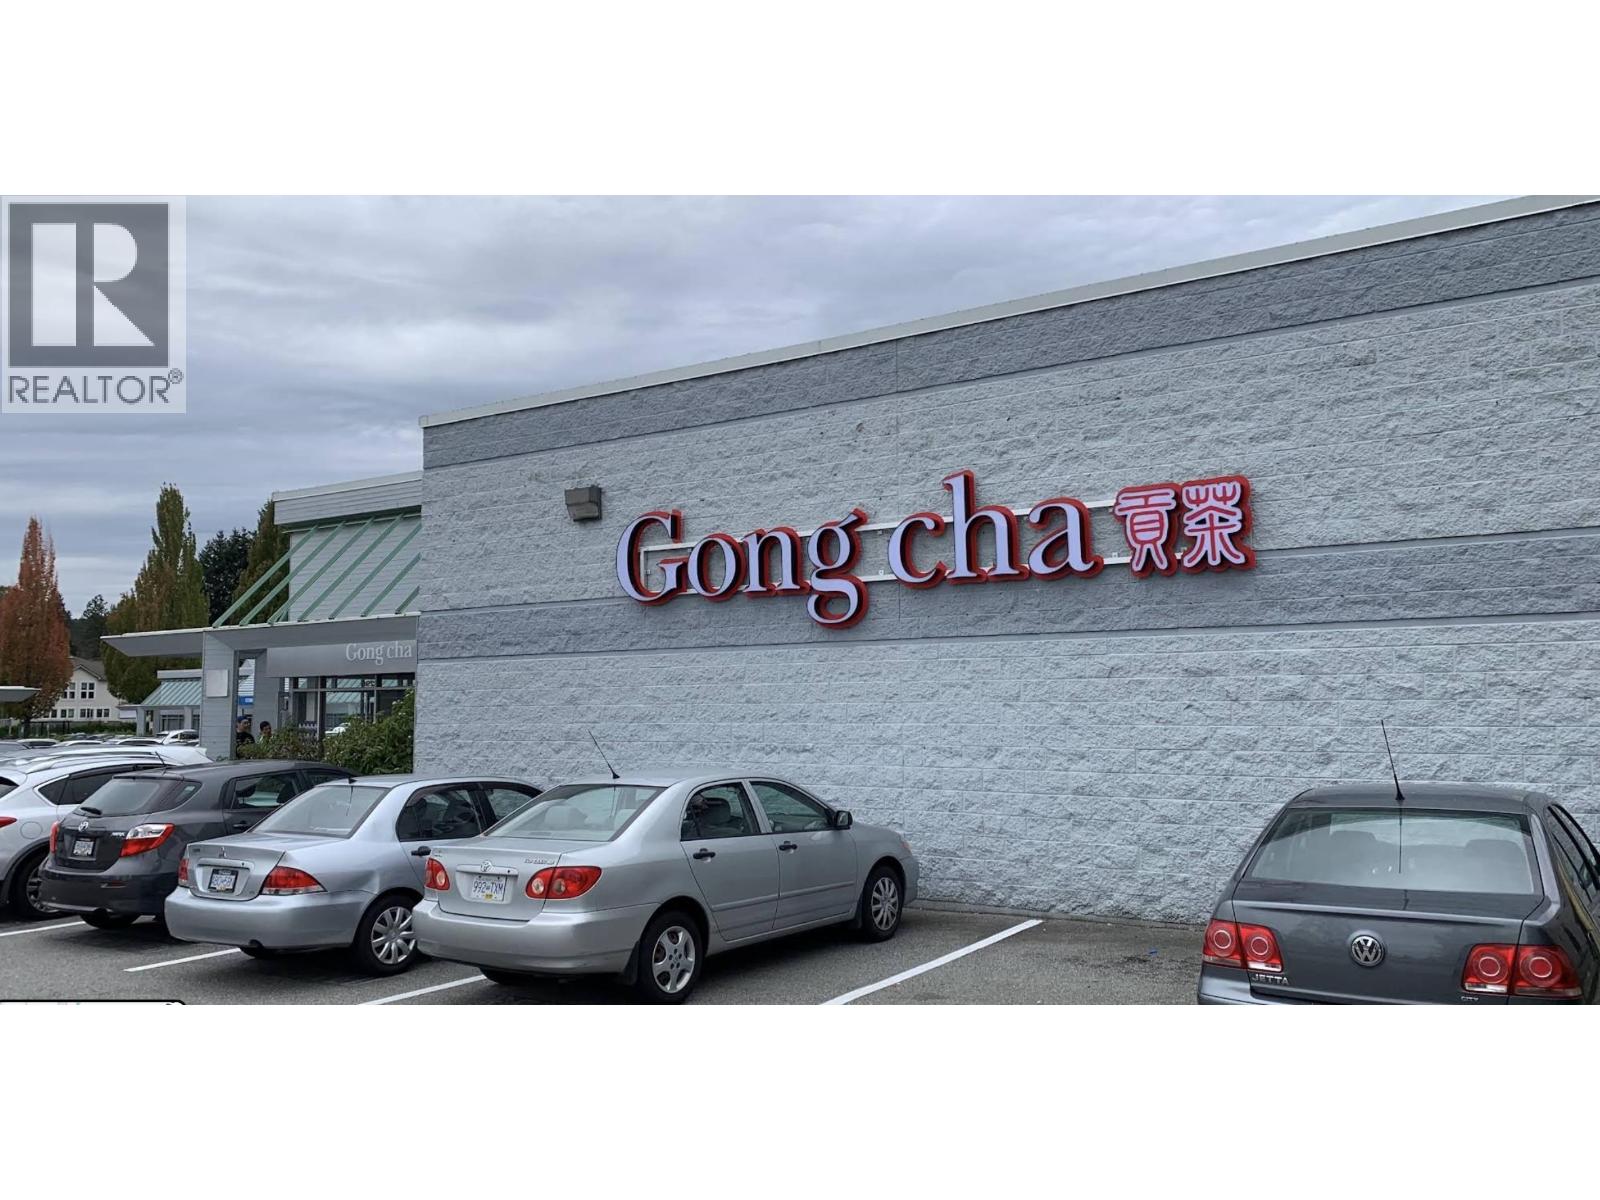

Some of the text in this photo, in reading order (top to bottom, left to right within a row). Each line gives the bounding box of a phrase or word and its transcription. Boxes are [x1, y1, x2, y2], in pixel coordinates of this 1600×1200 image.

[615, 470, 1103, 628] Gong cha
[1114, 475, 1256, 579] 貢茶
[345, 640, 413, 666] Gong cha
[1251, 973, 1289, 985] JETTA
